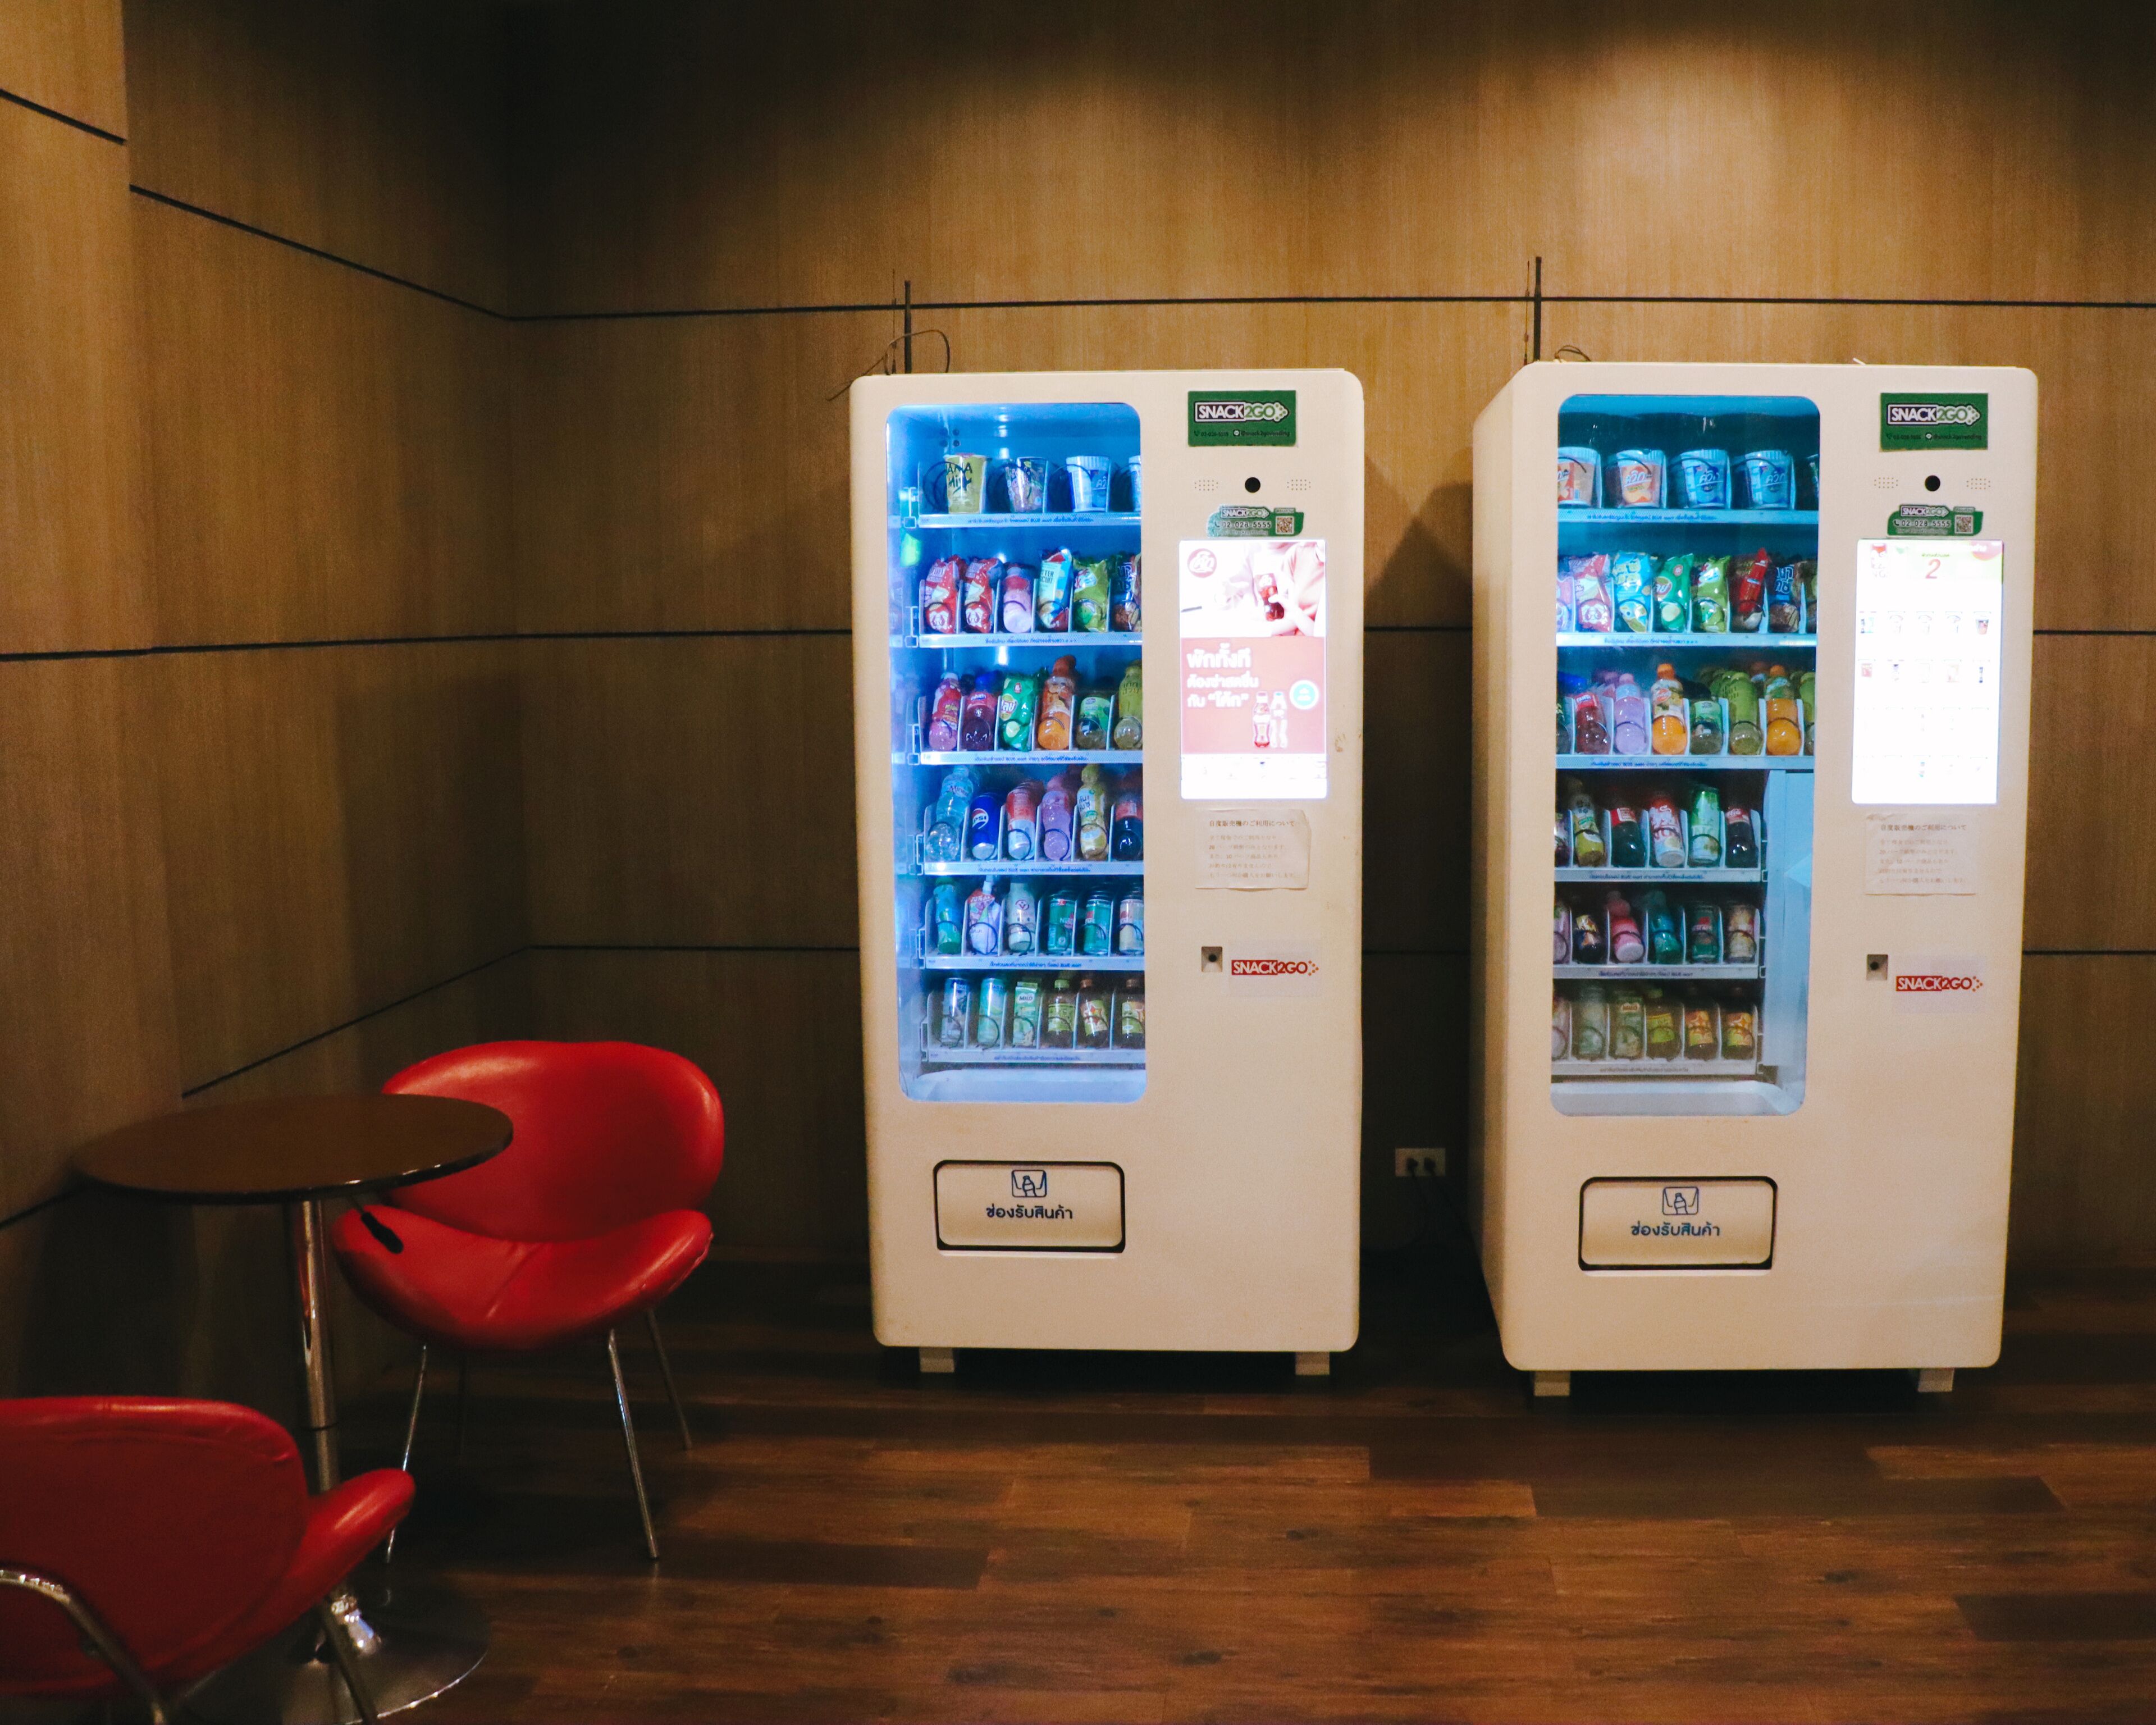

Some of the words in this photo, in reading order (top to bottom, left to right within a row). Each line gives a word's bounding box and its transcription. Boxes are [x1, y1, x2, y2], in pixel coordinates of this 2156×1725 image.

[1198, 404, 1276, 419] SNACK2GO
[1891, 408, 1967, 421] SNACK2GO
[1222, 508, 1264, 517] SNACK2GO
[1902, 507, 1943, 515] SNACK2GO
[1925, 559, 1941, 579] 2
[1233, 960, 1308, 975] SNACK2GO
[1898, 976, 1973, 991] SNACK2GO
[986, 1203, 1073, 1219] ช่องรับสินค้า
[1631, 1221, 1721, 1236] ช่องรับสินค้า
